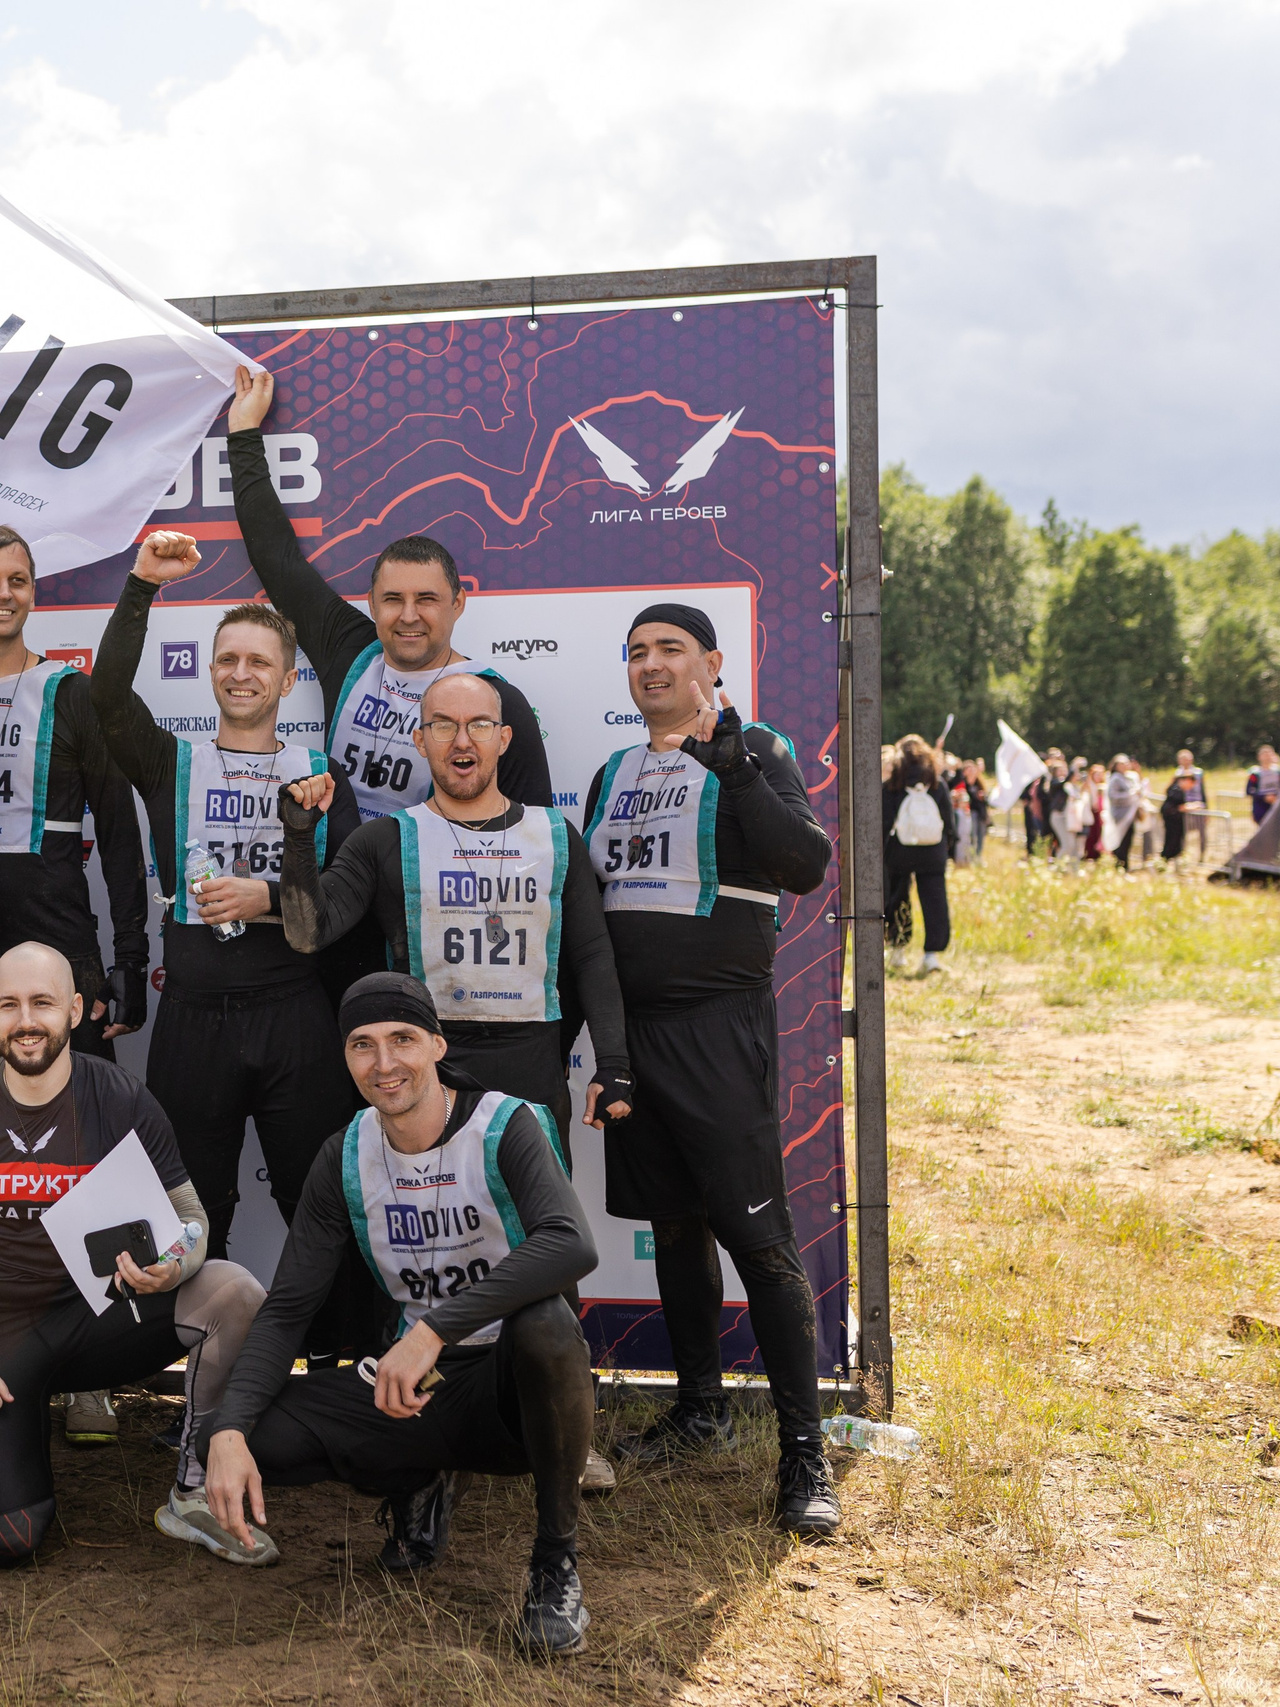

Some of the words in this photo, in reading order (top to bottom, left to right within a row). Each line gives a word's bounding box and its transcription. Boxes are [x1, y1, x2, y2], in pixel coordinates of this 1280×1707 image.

[14, 489, 49, 513] ВСЕХ
[589, 506, 643, 524] ЛИГА
[650, 504, 727, 521] ГЕРОЕВ
[491, 639, 559, 655] МАГУРО
[167, 649, 193, 672] 78
[356, 699, 419, 735] RODVI
[223, 769, 250, 778] ГОНКА
[250, 770, 281, 781] ГЕРОЕВ
[657, 763, 687, 773] ГЕРОЕВ
[613, 784, 689, 817] RODVIG
[453, 849, 484, 857] ГОНКА
[485, 849, 520, 857] ГЕРОЕВ
[443, 876, 537, 903] RODVIG
[622, 881, 668, 890] ГАЗПРОМБАНК
[443, 927, 527, 966] 6121
[470, 990, 523, 1000] ГАЗПРОМБАНК
[395, 1177, 421, 1188] ГОНКА
[423, 1172, 456, 1186] ГЕРОЕВ
[389, 1204, 481, 1241] RODVIG
